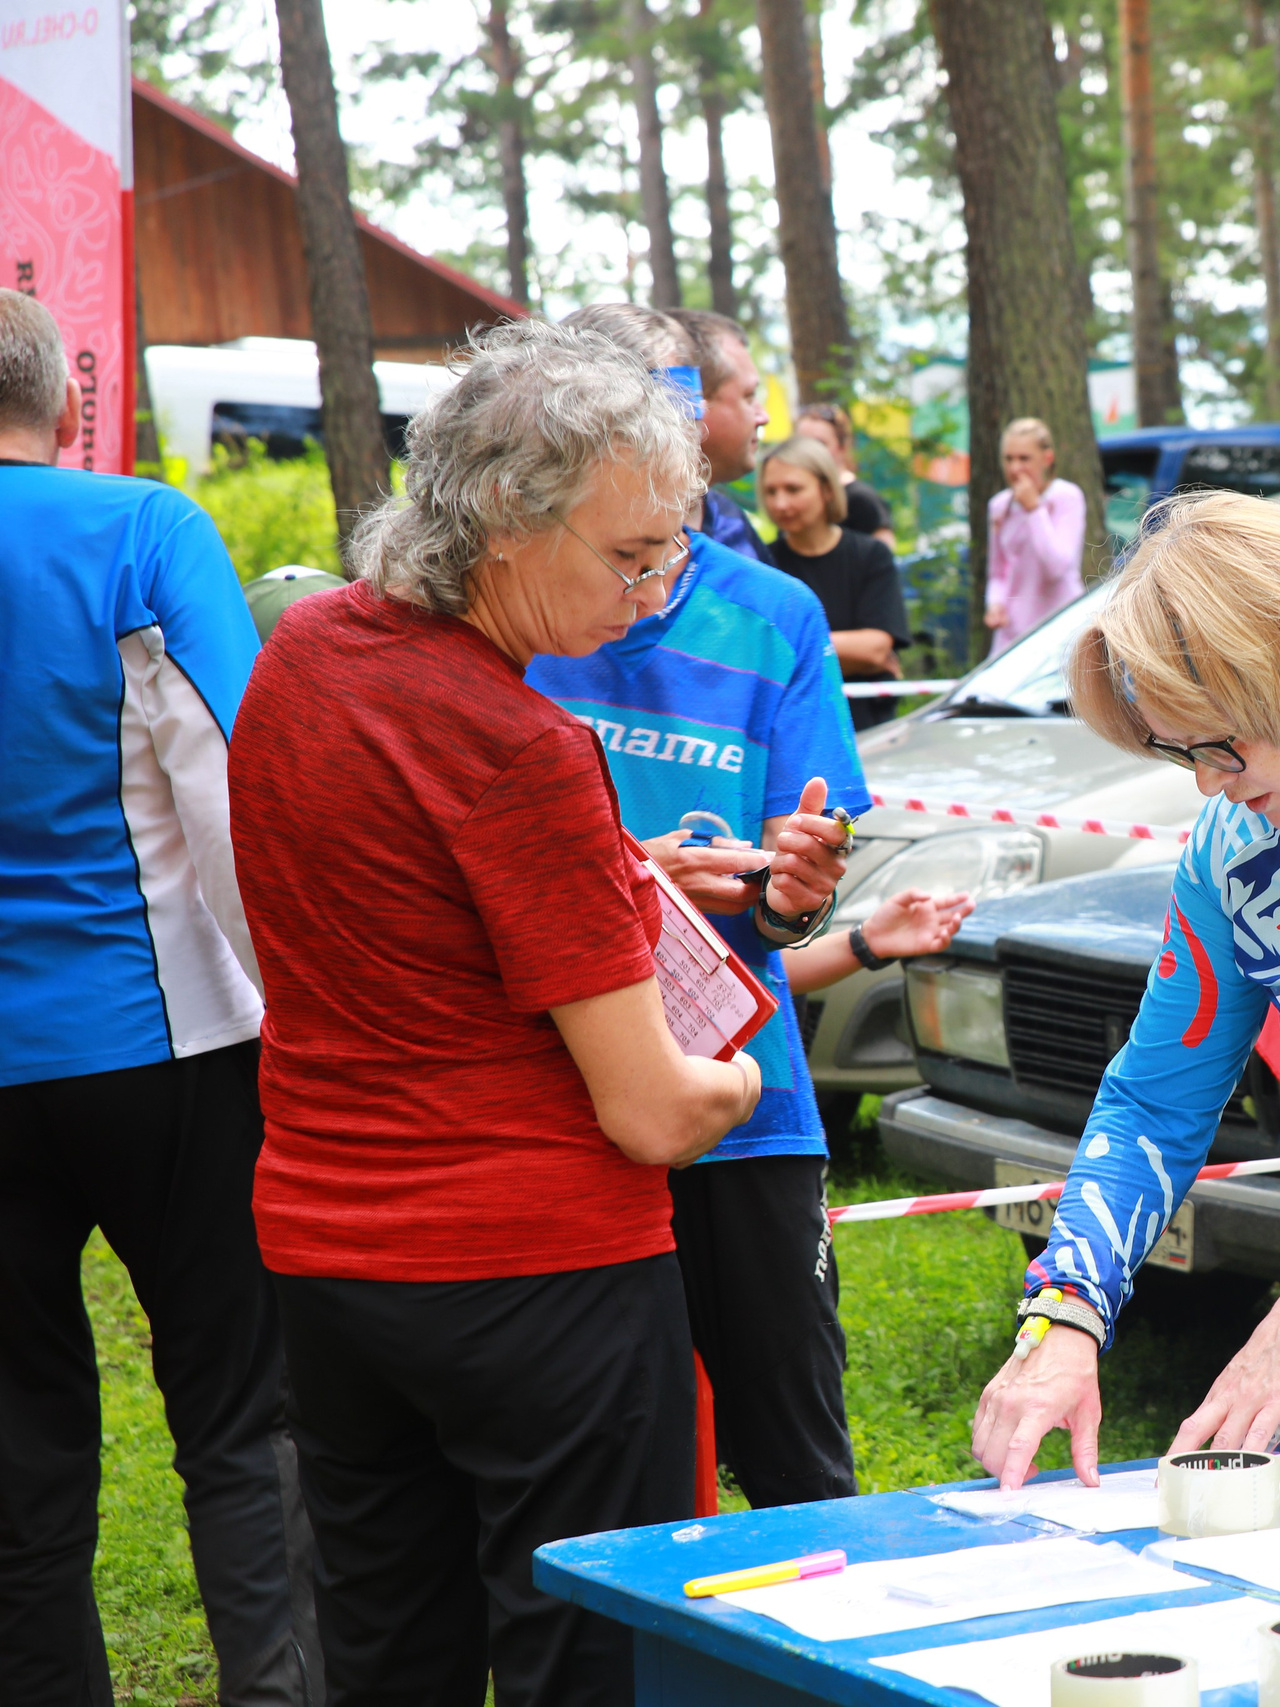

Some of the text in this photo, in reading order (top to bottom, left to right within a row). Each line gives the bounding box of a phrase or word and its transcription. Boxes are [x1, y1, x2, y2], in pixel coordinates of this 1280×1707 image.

[679, 960, 692, 972] 501
[662, 977, 676, 991] 503
[696, 1015, 708, 1028] 703
[671, 1005, 684, 1019] 604
[688, 1022, 699, 1037] 704
[679, 1032, 691, 1046] 705
